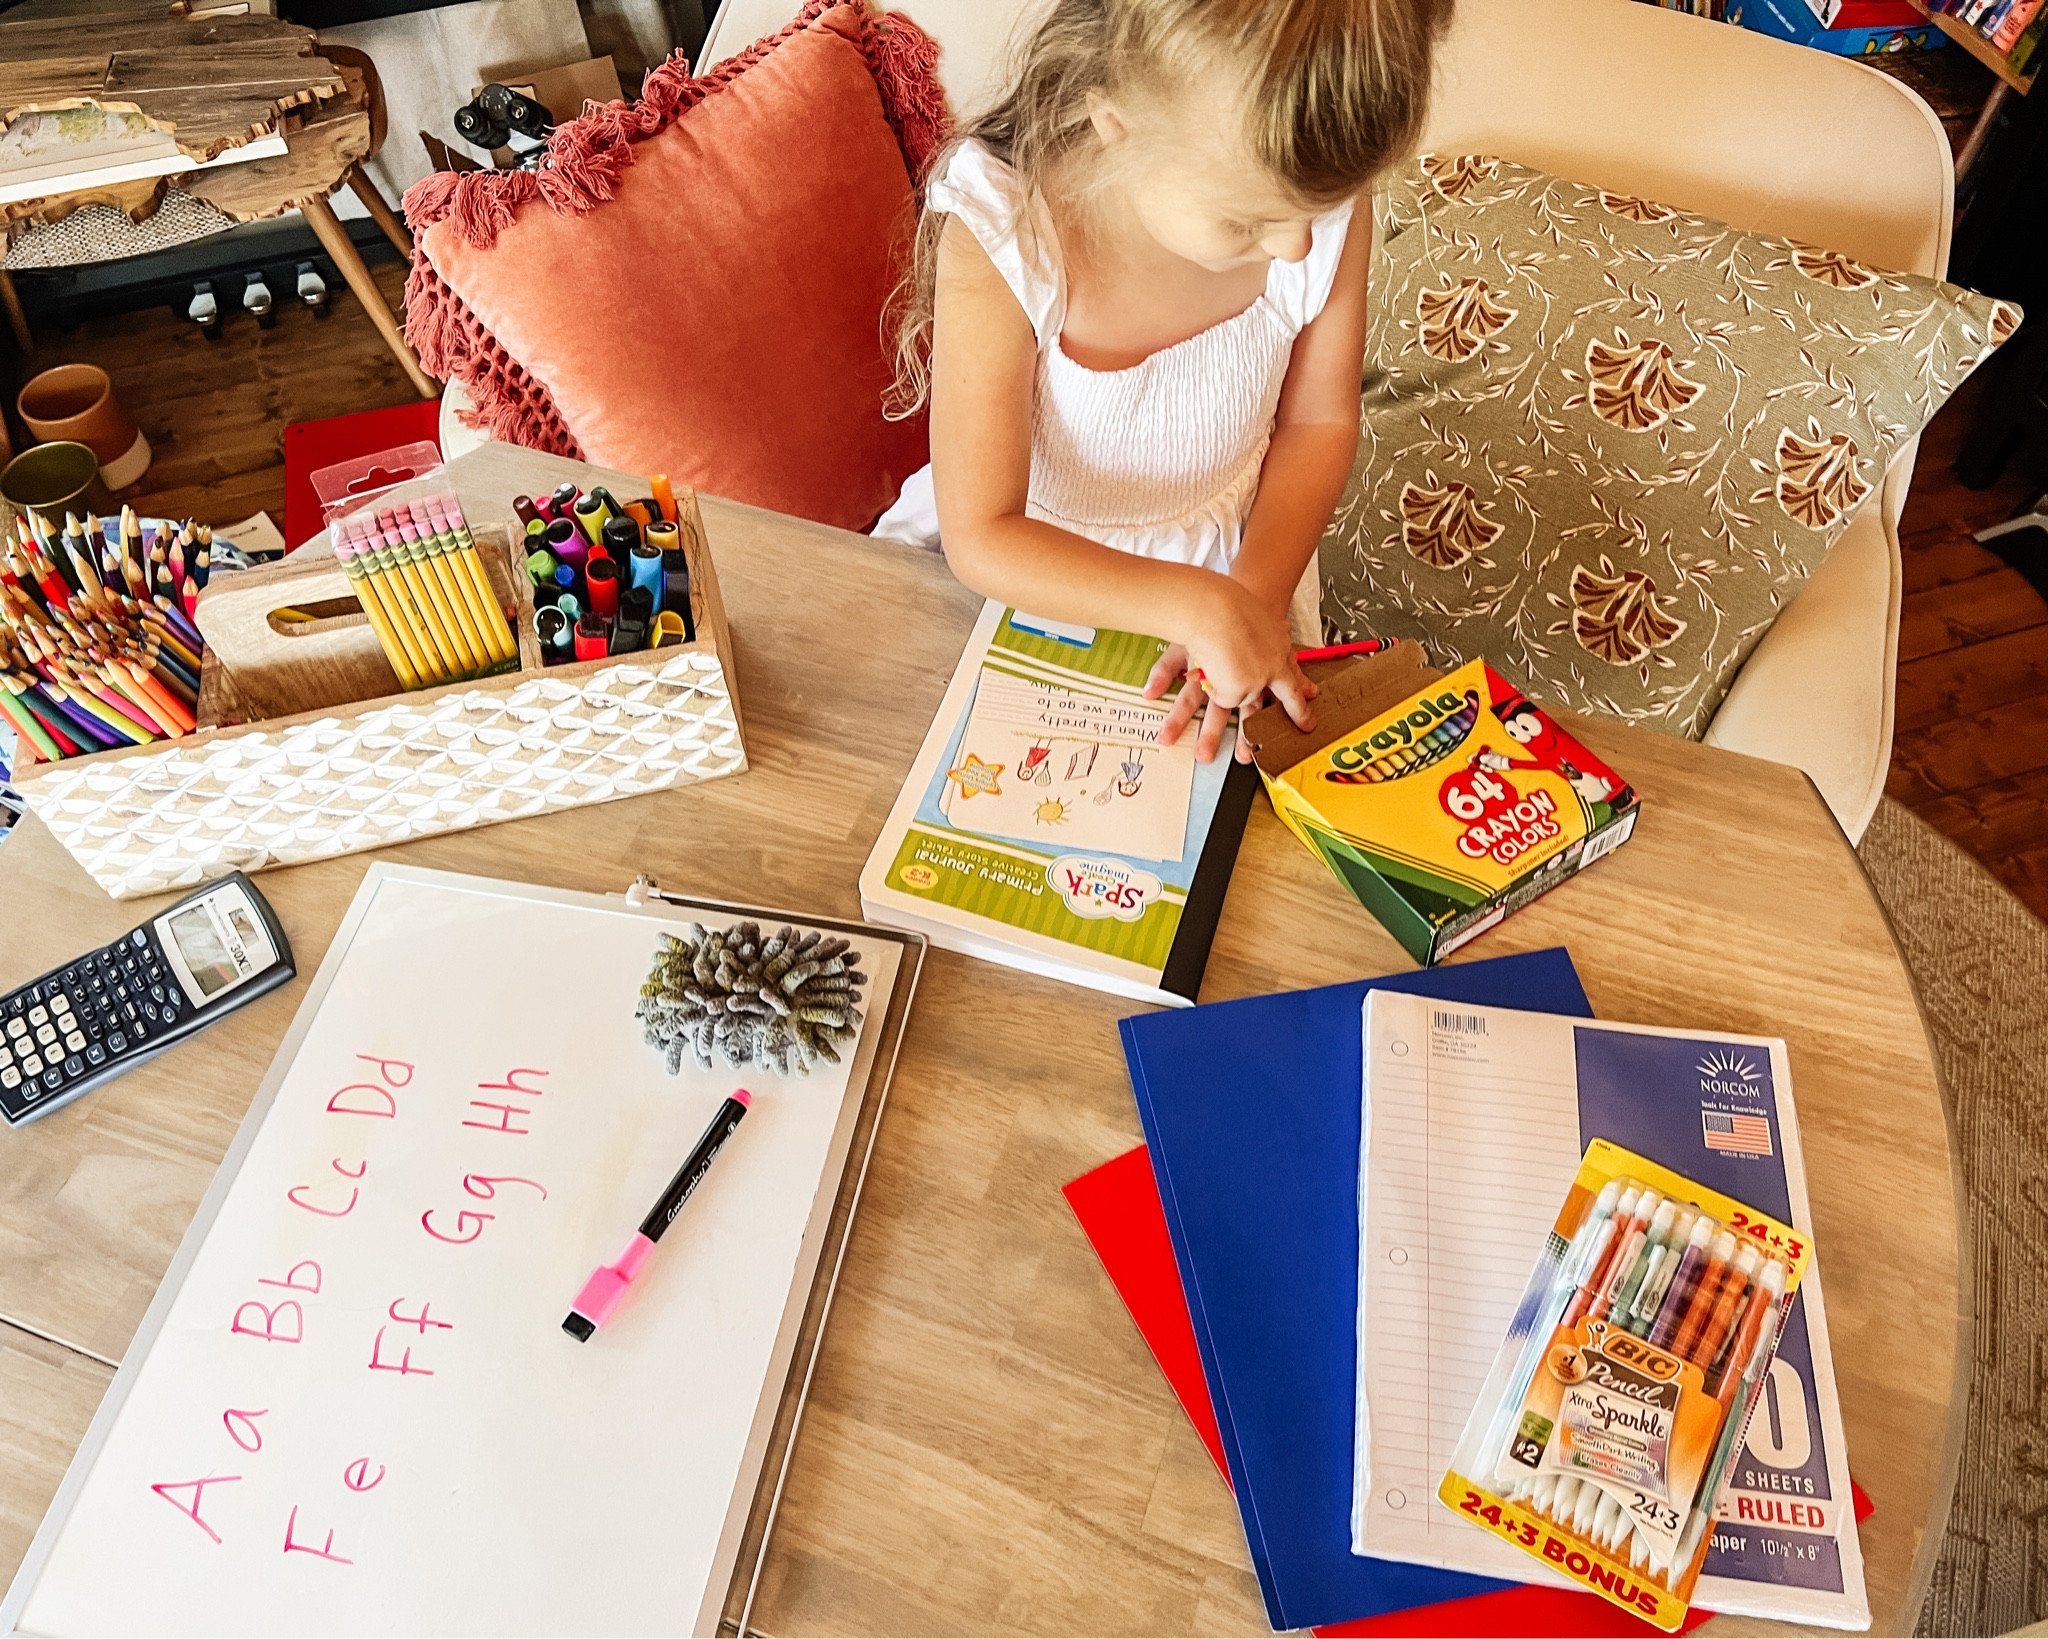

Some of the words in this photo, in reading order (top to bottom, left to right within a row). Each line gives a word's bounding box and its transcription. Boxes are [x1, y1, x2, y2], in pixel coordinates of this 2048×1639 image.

[1037, 698, 1051, 710] to
[1059, 700, 1076, 712] go
[1083, 704, 1102, 714] we
[1109, 708, 1164, 723] outside
[1038, 712, 1087, 729] pretty
[1093, 723, 1112, 736] it's
[1331, 689, 1464, 771] Crayola
[1447, 770, 1506, 819] 64
[1457, 790, 1556, 858] CRAYON
[920, 839, 954, 857] Tablet
[1492, 816, 1560, 864] COLORS
[914, 848, 976, 875] Journal
[958, 849, 989, 866] Story
[992, 859, 1040, 880] Creative
[1508, 854, 1540, 878] Sharpener
[978, 867, 1044, 895] Primary
[1079, 862, 1131, 884] Imagine
[1080, 870, 1117, 886] Create
[1065, 868, 1144, 910] Spark
[462, 1066, 549, 1135] Hh
[1701, 1078, 1761, 1099] NORCOM
[231, 1260, 322, 1343] Bb
[326, 1053, 415, 1118] Dd
[422, 1172, 548, 1244] Gg
[369, 1297, 453, 1376] Ff
[1585, 1361, 1665, 1407] Pencil
[1516, 1440, 1539, 1464] #2
[1745, 1470, 1815, 1496] SHEETS
[1629, 1492, 1680, 1531] 24+3
[1737, 1495, 1826, 1529] RULED
[1459, 1491, 1540, 1546] 24+3
[1542, 1539, 1659, 1617] BONUS
[1709, 1533, 1747, 1554] aper
[1796, 1547, 1805, 1560] x
